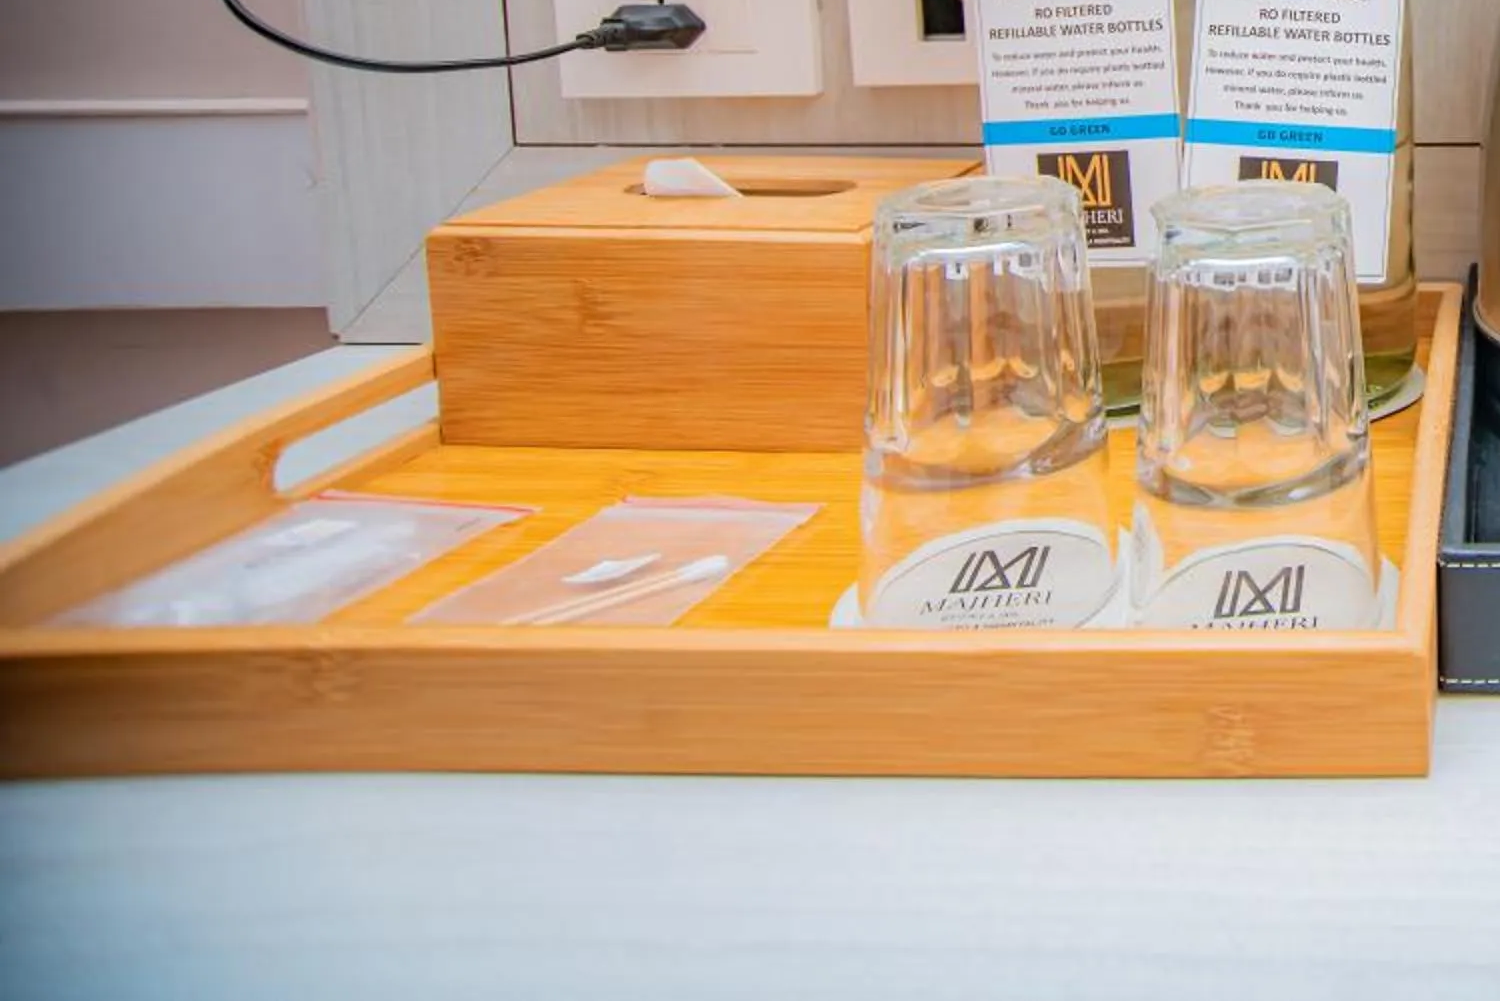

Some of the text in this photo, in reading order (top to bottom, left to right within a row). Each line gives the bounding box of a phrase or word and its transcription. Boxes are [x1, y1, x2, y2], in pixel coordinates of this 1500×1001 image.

[1035, 4, 1113, 19] RO FILTERED
[1259, 9, 1341, 24] RO FILTERED
[989, 19, 1163, 40] REFILLABLE WATER BOTTLES
[1208, 24, 1391, 46] REFILLABLE WATER BOTTLES
[1050, 124, 1110, 135] GO GREEN
[1257, 130, 1323, 142] GO GREEN
[1084, 209, 1123, 225] HERI
[1192, 616, 1318, 629] HERI
